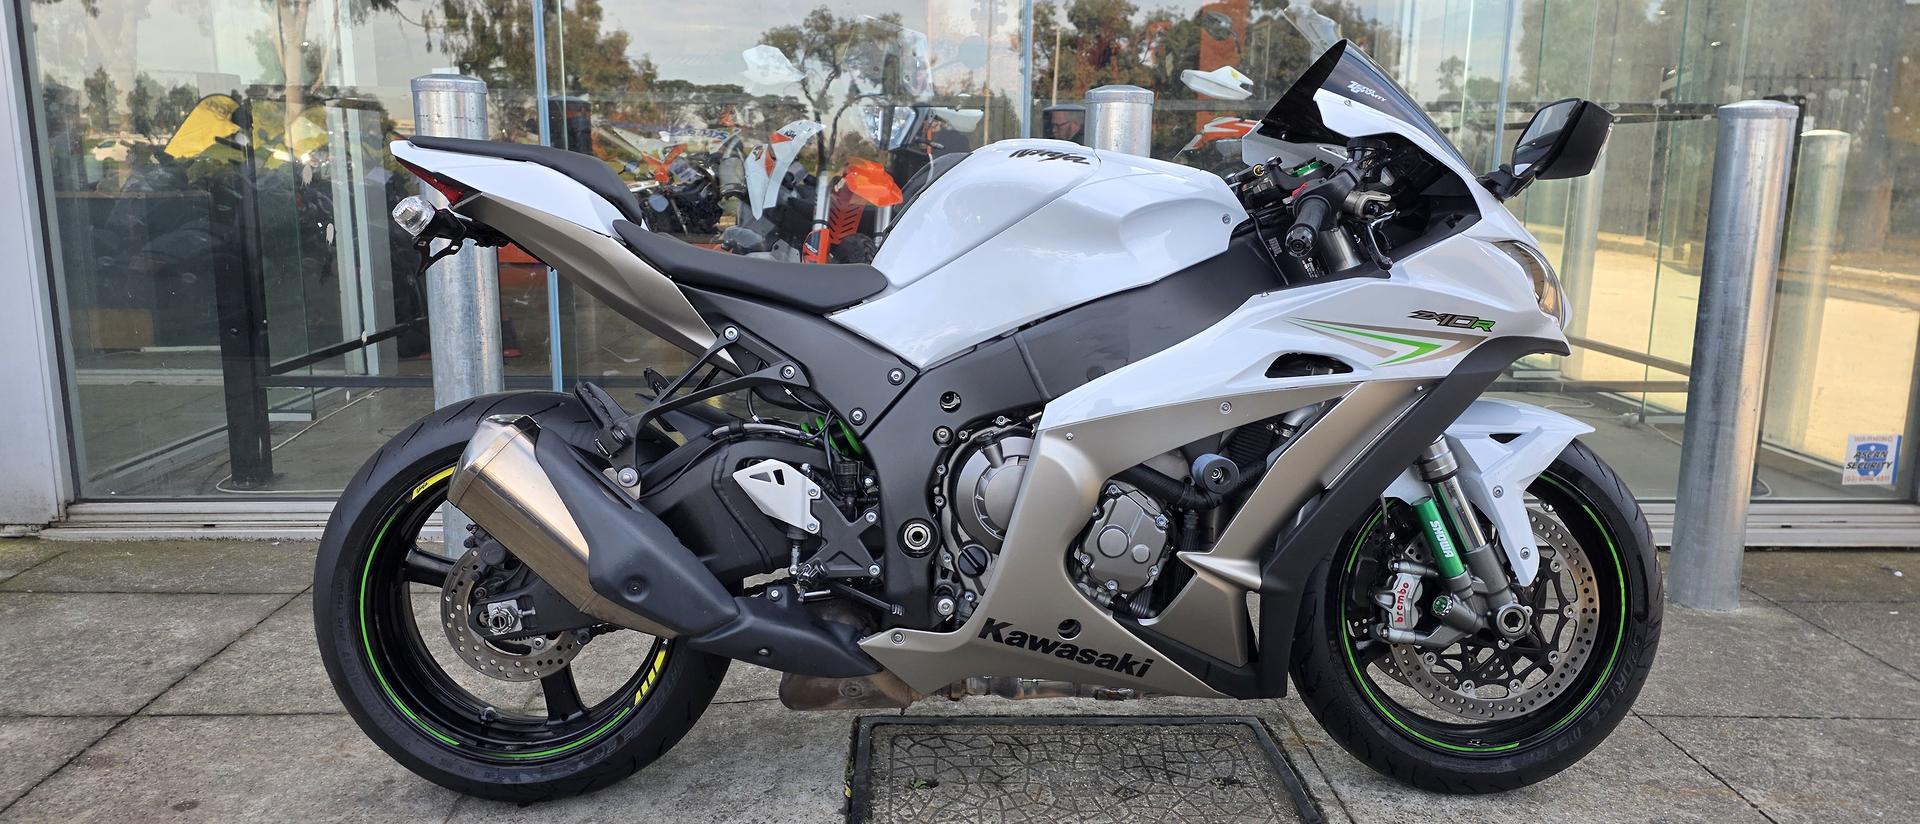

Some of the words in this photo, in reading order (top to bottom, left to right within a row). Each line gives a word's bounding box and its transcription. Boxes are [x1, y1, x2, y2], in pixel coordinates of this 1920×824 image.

[1008, 148, 1090, 165] Ninja
[1845, 461, 1893, 470] SECURITY
[1429, 520, 1454, 558] SHOWA
[1394, 582, 1410, 623] brembo
[977, 617, 1154, 678] Kawasaki
